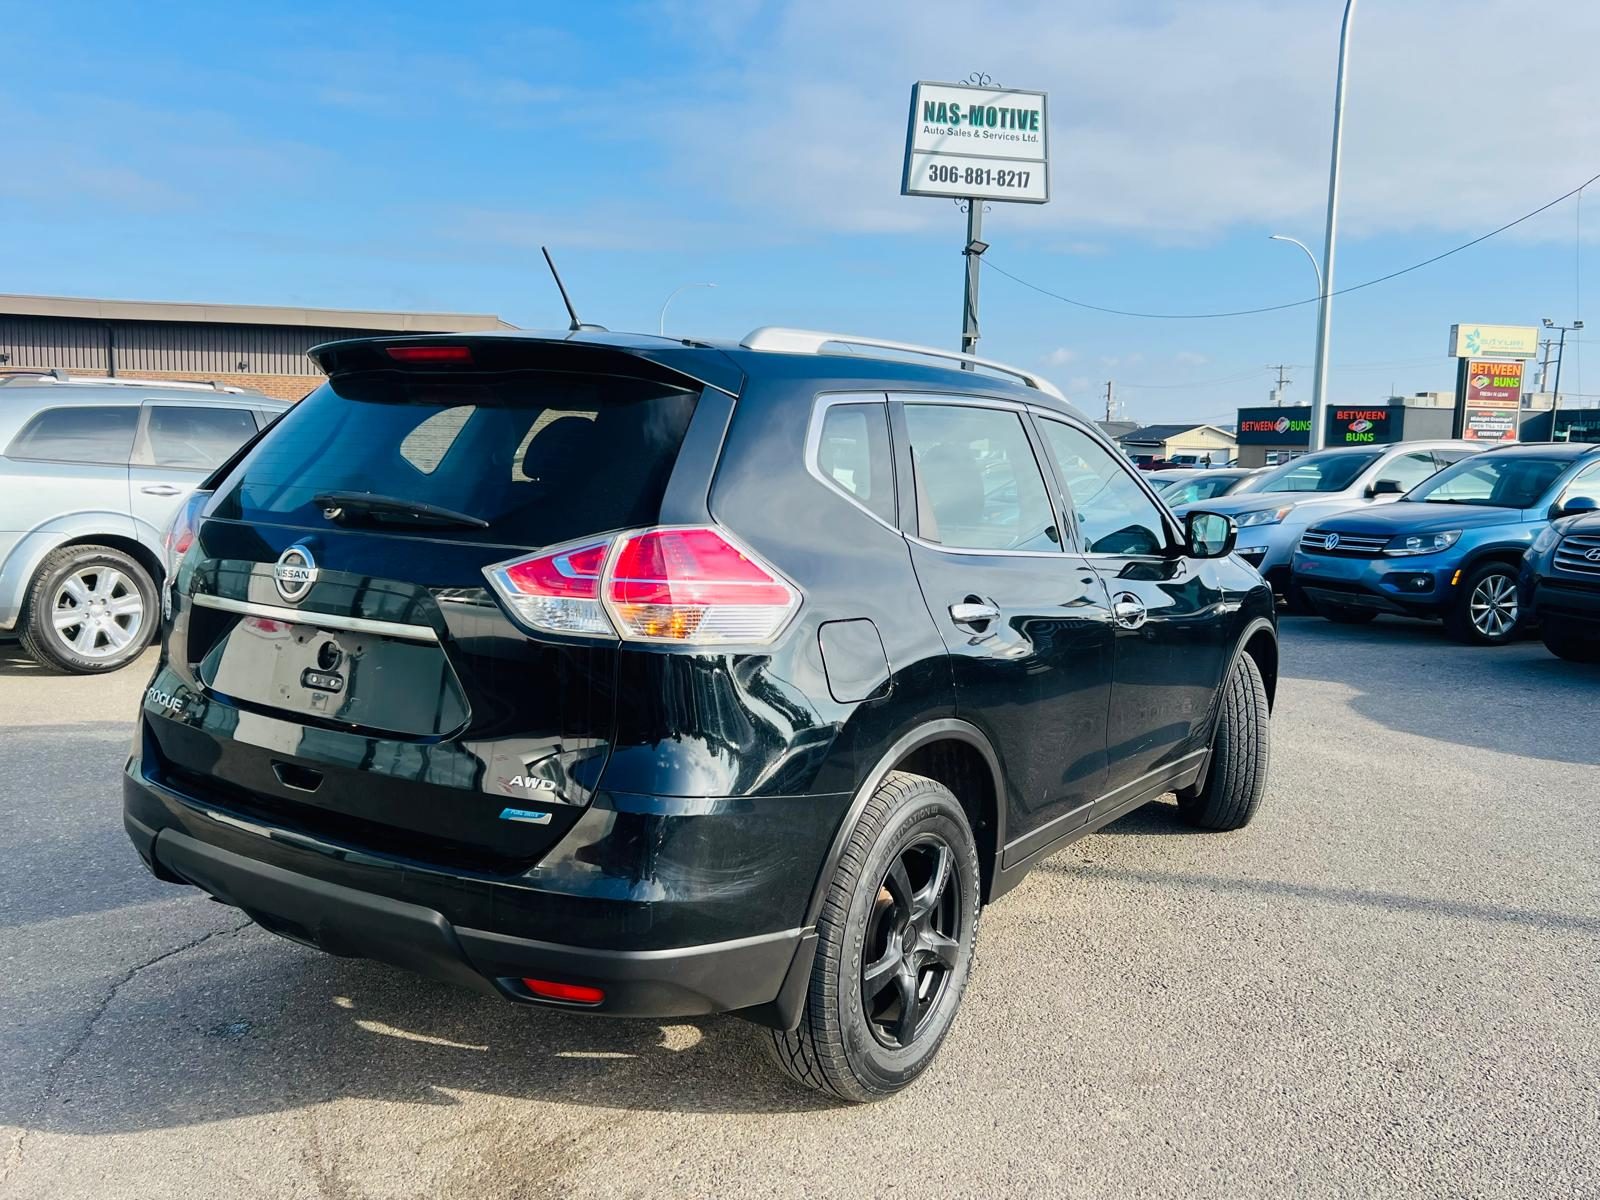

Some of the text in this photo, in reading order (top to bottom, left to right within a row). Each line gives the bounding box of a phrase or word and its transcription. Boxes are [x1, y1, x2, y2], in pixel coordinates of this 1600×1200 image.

[923, 100, 1039, 131] NAS-MOTIVE
[923, 125, 1039, 143] Auto Sales & Services Ltd.
[928, 164, 1031, 188] 306-881-8217
[1471, 363, 1521, 376] BETWEEN
[1493, 377, 1520, 388] BUNS
[1336, 410, 1386, 420] BETWEEN
[1241, 420, 1312, 432] BETWEEN BUNS
[1345, 433, 1374, 442] BUNS
[275, 567, 310, 579] NISSAN
[147, 687, 183, 712] ROGUE
[508, 775, 557, 791] AWD
